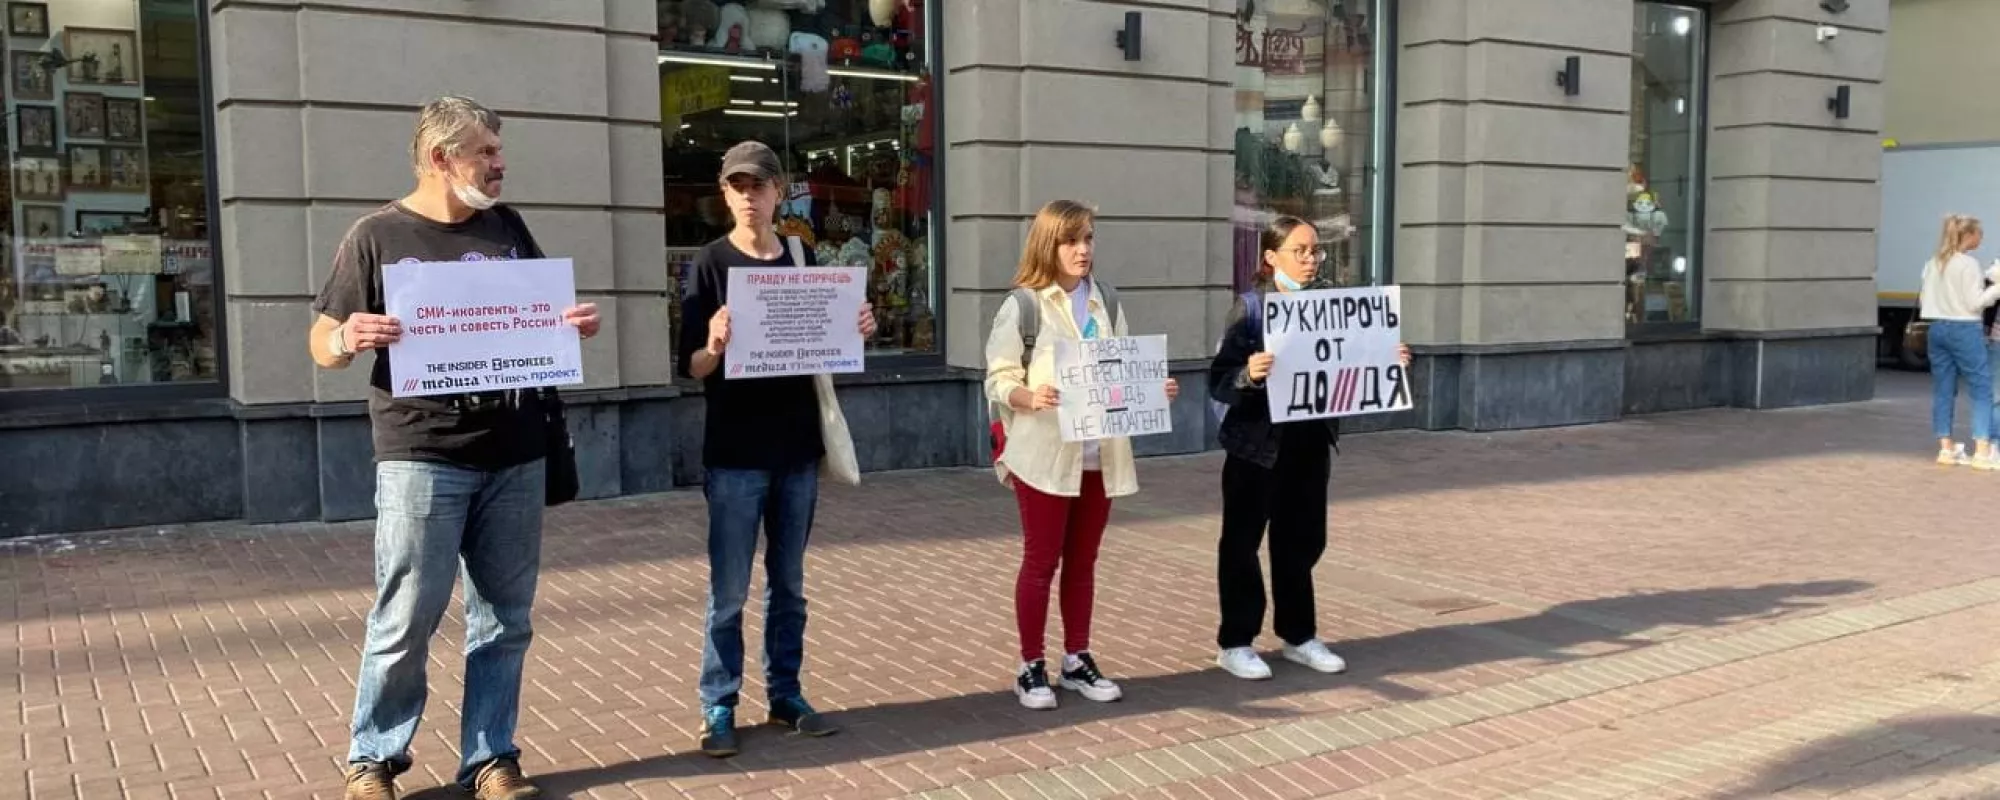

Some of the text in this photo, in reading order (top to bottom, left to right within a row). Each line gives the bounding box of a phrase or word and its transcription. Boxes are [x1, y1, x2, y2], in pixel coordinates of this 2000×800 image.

[747, 274, 786, 286] ПРАВДУ
[789, 273, 801, 284] НЕ
[416, 304, 518, 319] СМИ-иноагенты
[531, 303, 551, 313] это
[409, 323, 445, 335] честь
[450, 324, 457, 333] и
[461, 320, 510, 332] совесть
[1078, 338, 1139, 358] ПРАВДА
[1315, 337, 1344, 362] ОТ
[427, 363, 447, 373] THE
[448, 360, 487, 371] INSIDER
[422, 376, 479, 390] meduza
[484, 373, 528, 385] VTimes
[1061, 366, 1080, 386] НЕ
[1073, 415, 1097, 437] НЕ
